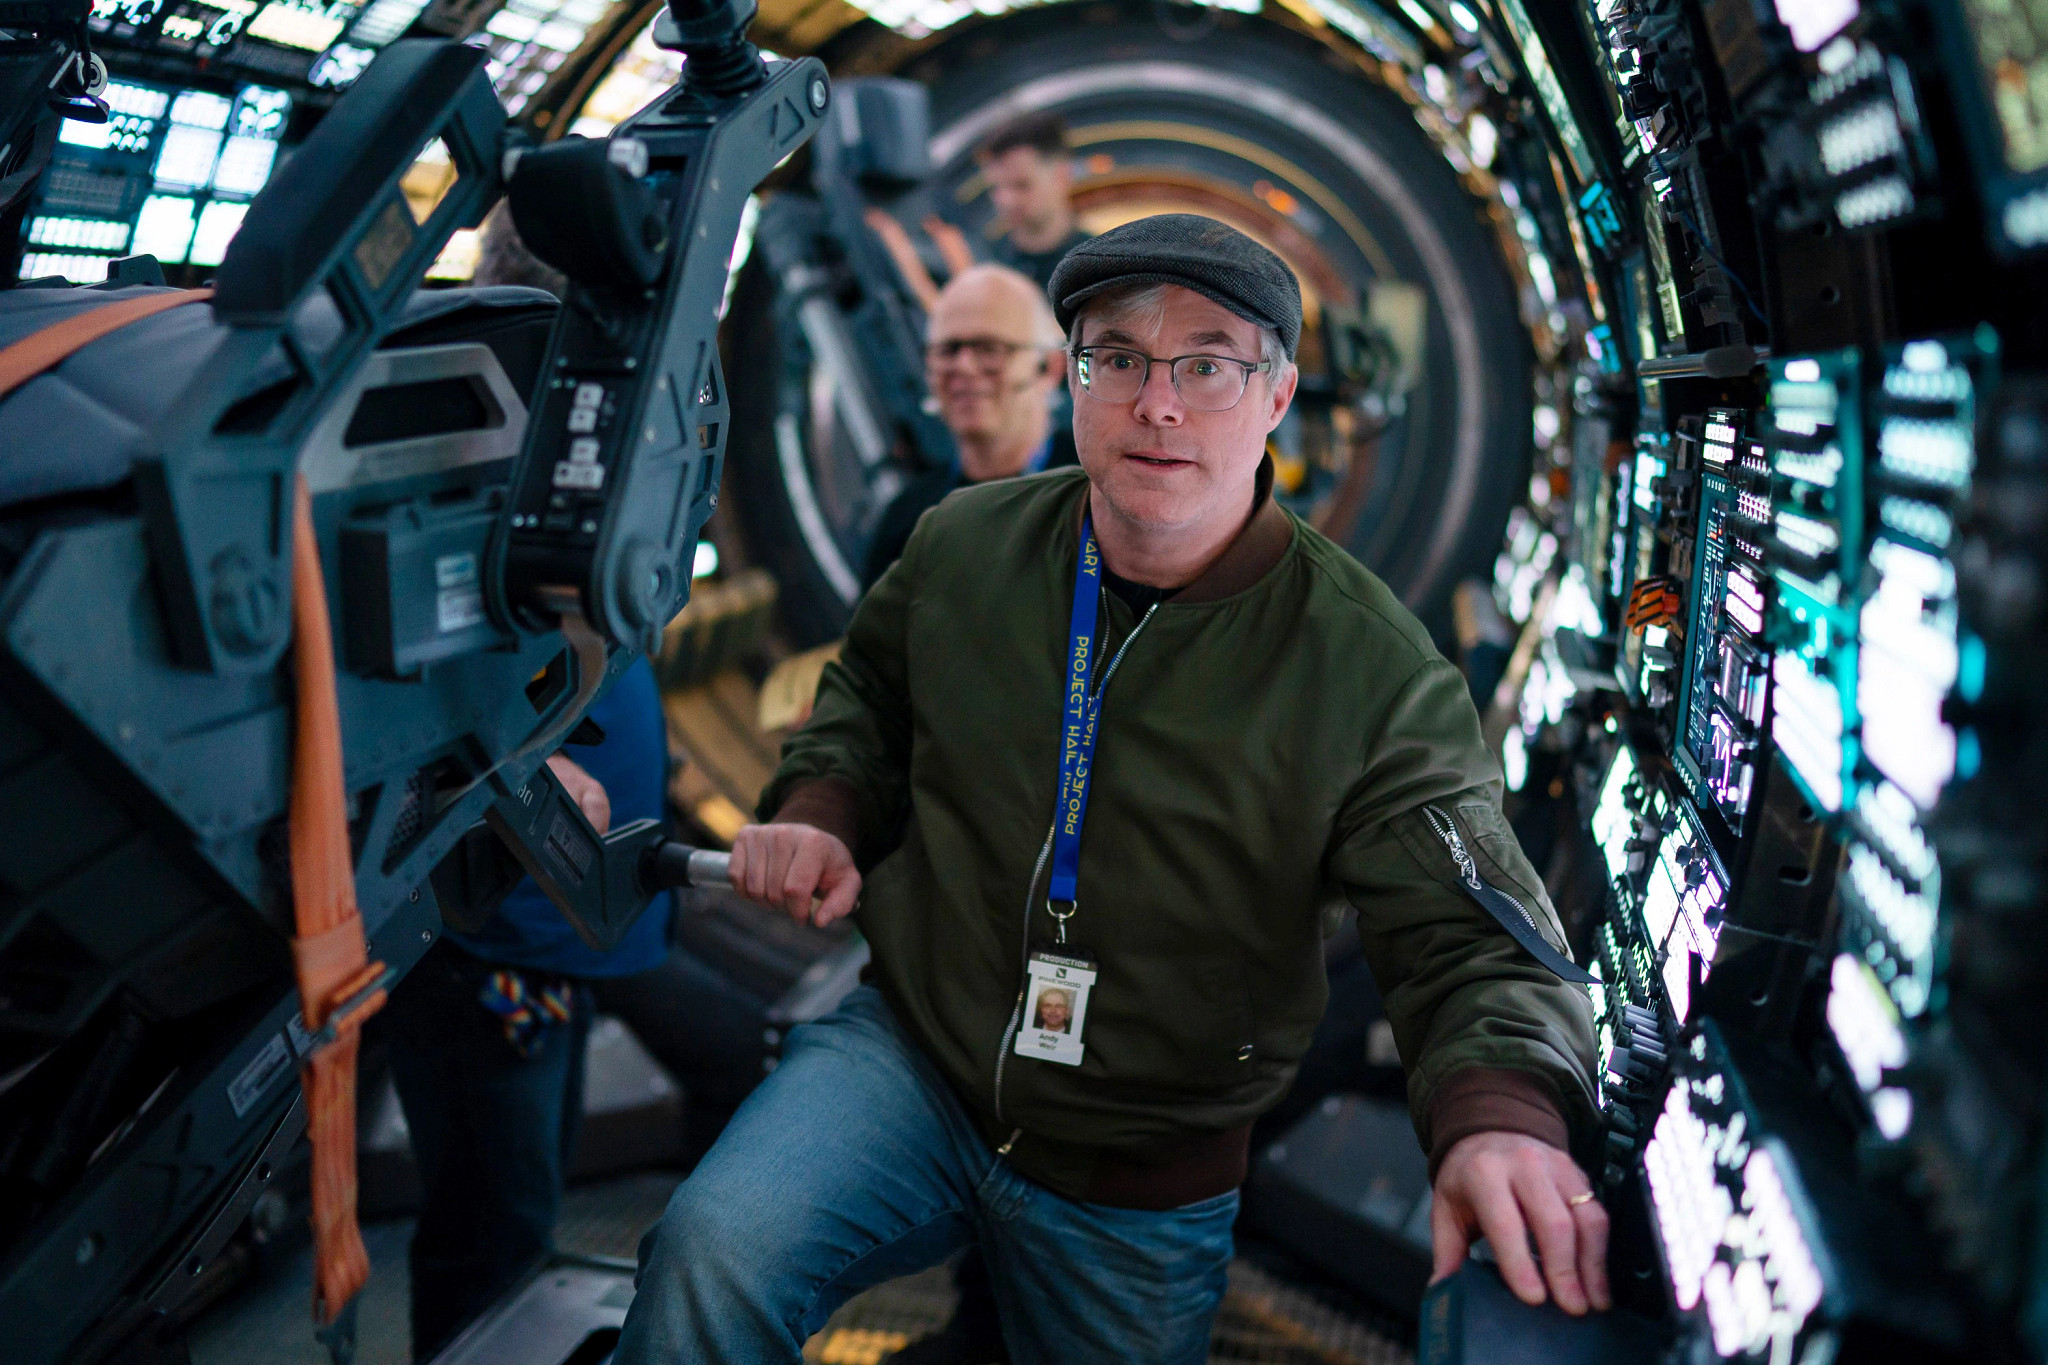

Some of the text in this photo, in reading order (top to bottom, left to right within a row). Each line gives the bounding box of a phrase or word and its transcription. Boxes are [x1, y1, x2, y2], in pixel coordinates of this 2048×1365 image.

[1069, 636, 1089, 719] PROJECT
[1066, 725, 1080, 764] HAIL
[1065, 752, 1088, 835] PROJECT
[1082, 707, 1098, 746] HAIL
[1040, 953, 1089, 968] PRODUCTION
[1039, 1033, 1059, 1043] Andy
